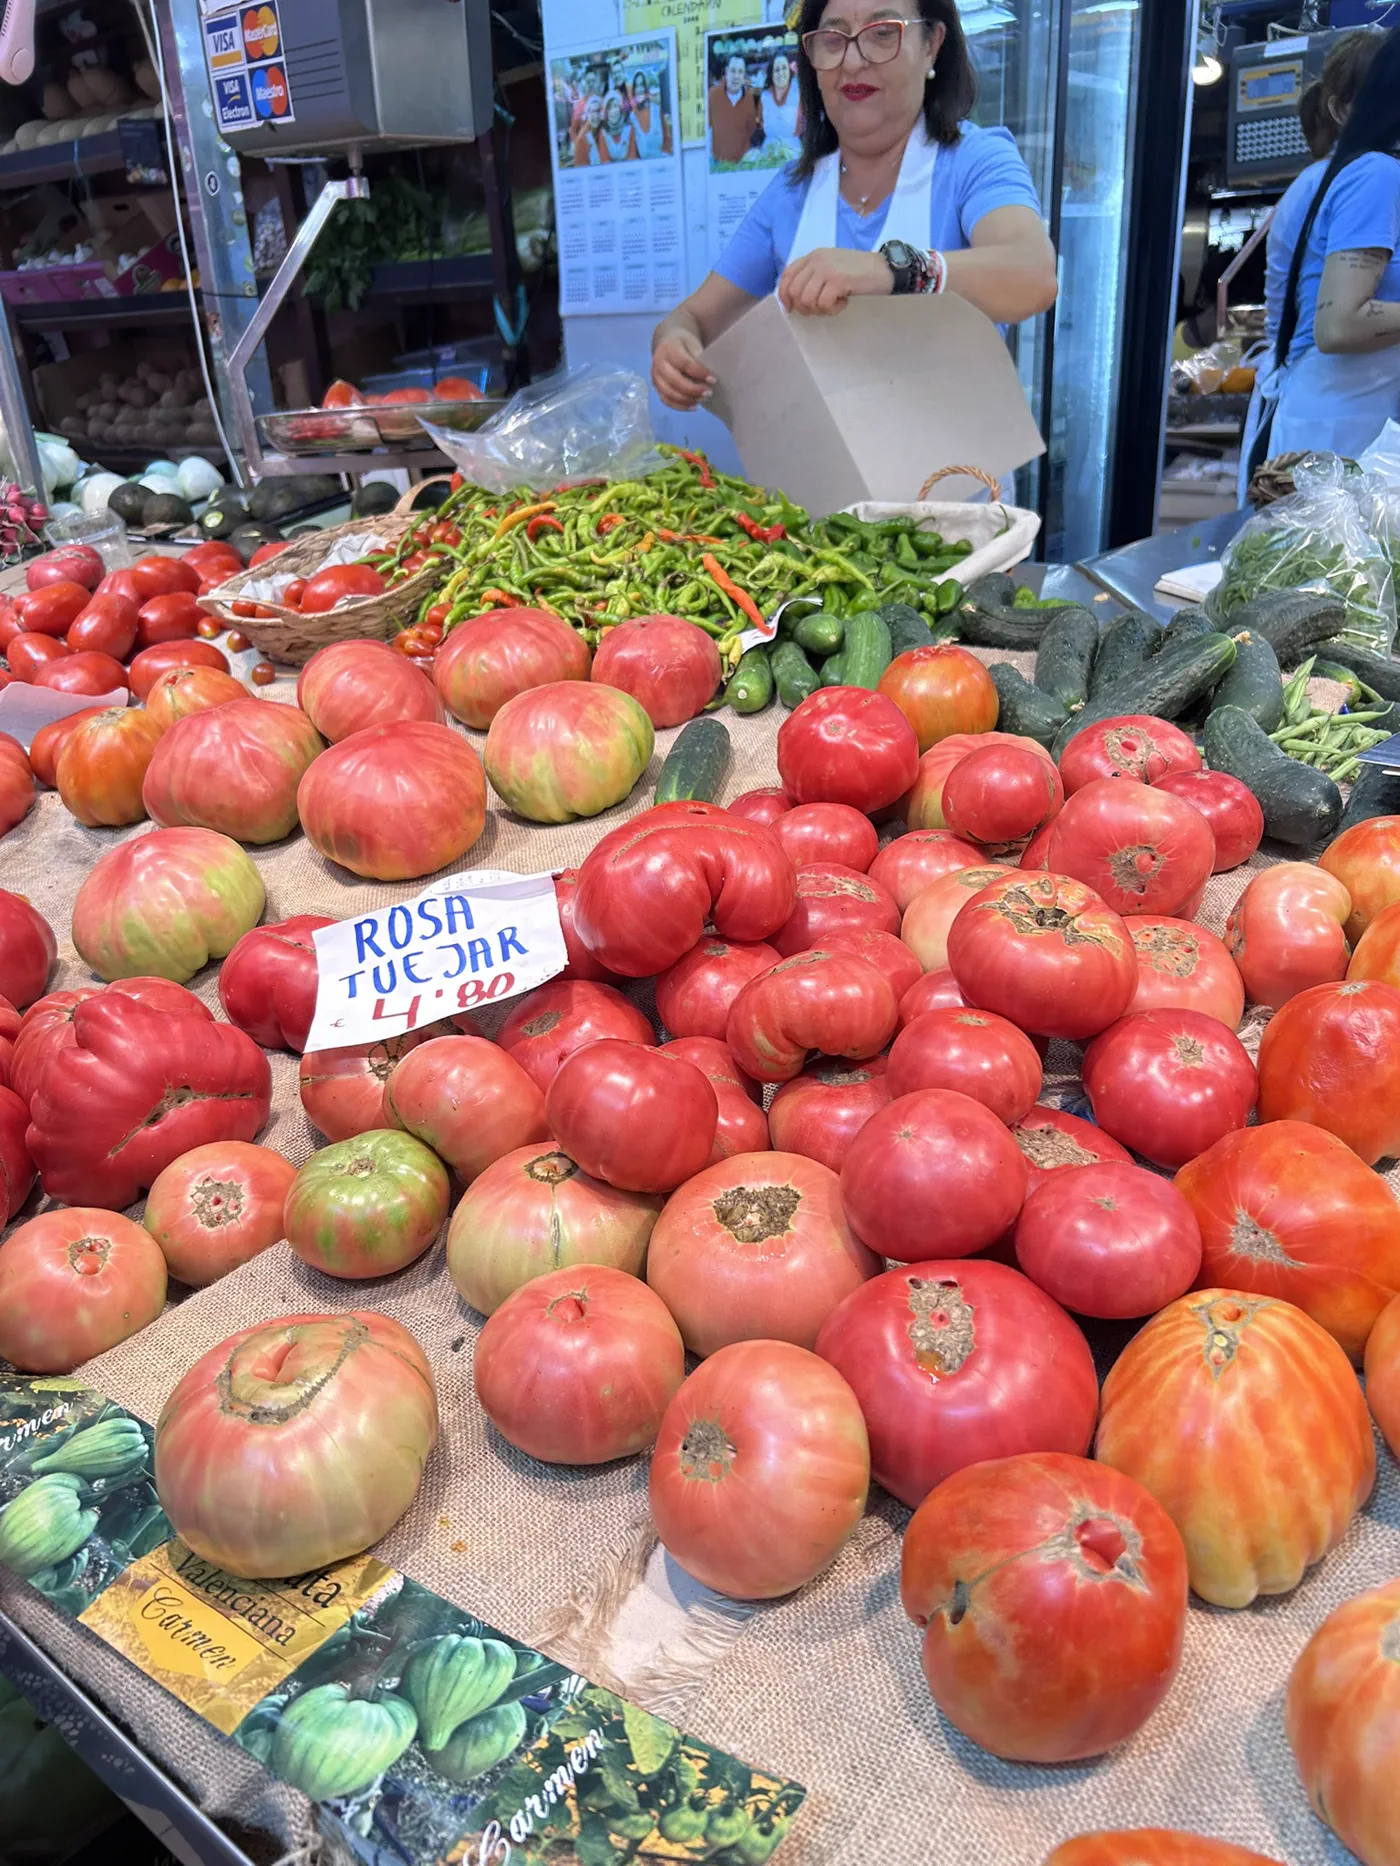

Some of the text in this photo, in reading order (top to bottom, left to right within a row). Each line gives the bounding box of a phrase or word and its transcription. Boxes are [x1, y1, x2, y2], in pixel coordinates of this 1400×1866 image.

[213, 32, 235, 52] VISA
[244, 24, 277, 41] MasterCard
[223, 80, 239, 94] VISA
[256, 85, 283, 100] Maestro
[221, 105, 250, 120] Electron
[354, 895, 475, 963] ROSA
[0, 1402, 74, 1452] rmen
[175, 1552, 296, 1647] Valenciana
[140, 1586, 237, 1671] Carmen
